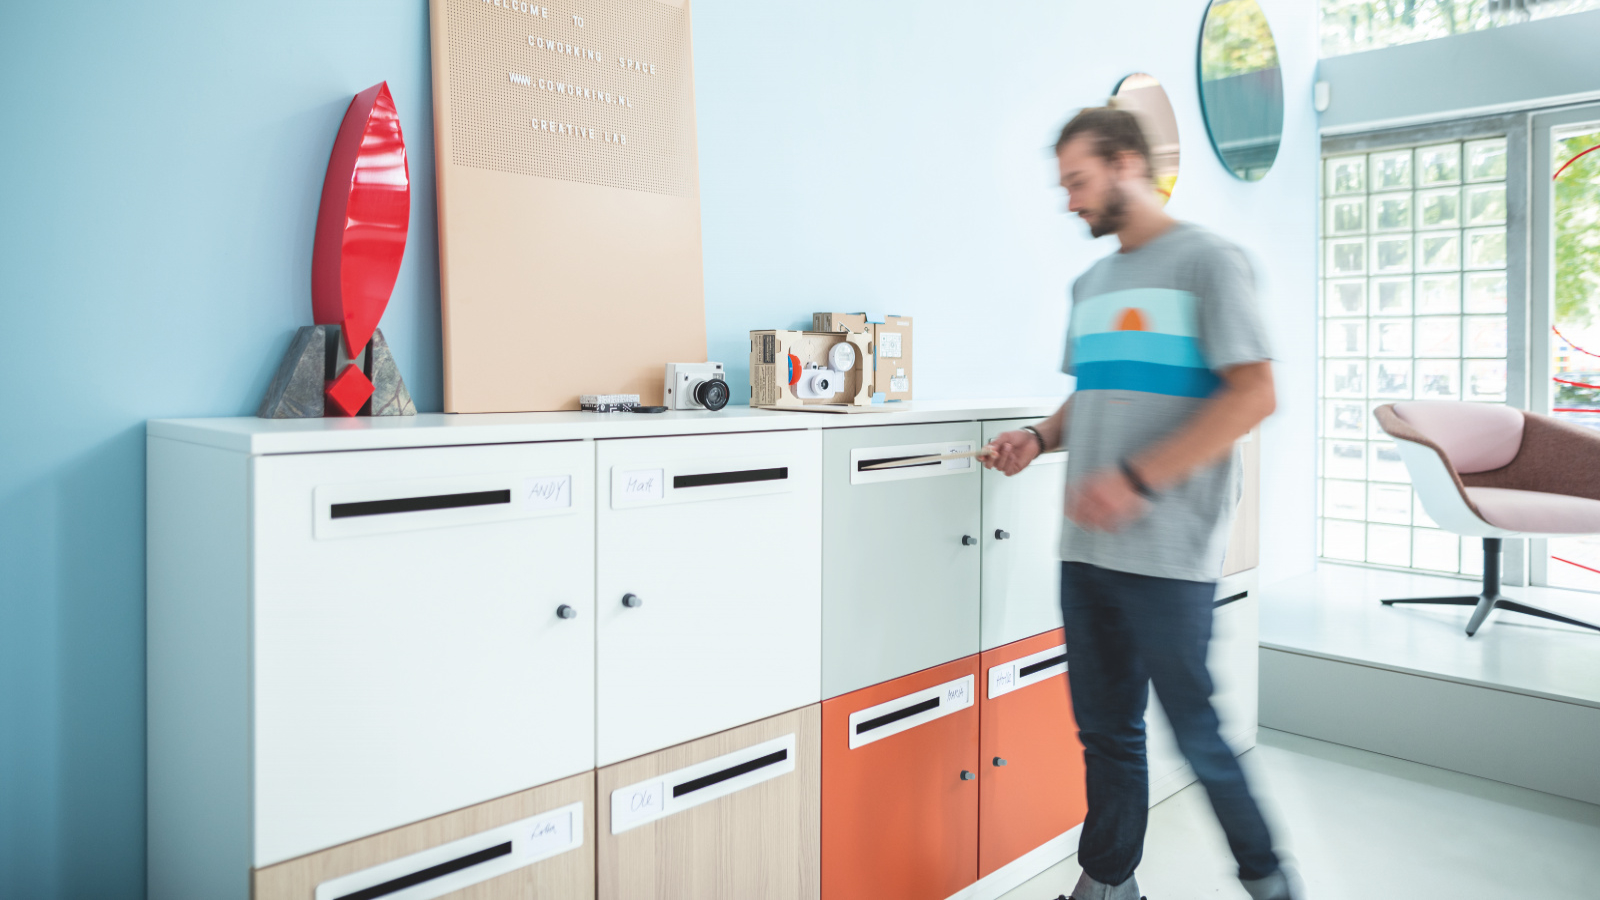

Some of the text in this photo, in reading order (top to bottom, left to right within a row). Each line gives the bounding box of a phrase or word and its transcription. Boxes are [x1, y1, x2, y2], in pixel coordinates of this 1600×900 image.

[572, 15, 584, 28] TO
[528, 35, 656, 75] COWORKING SPACE
[508, 72, 632, 108] WWW.COWORKING.NL
[531, 118, 627, 145] CREATIVE LAB
[528, 480, 566, 501] ANDY
